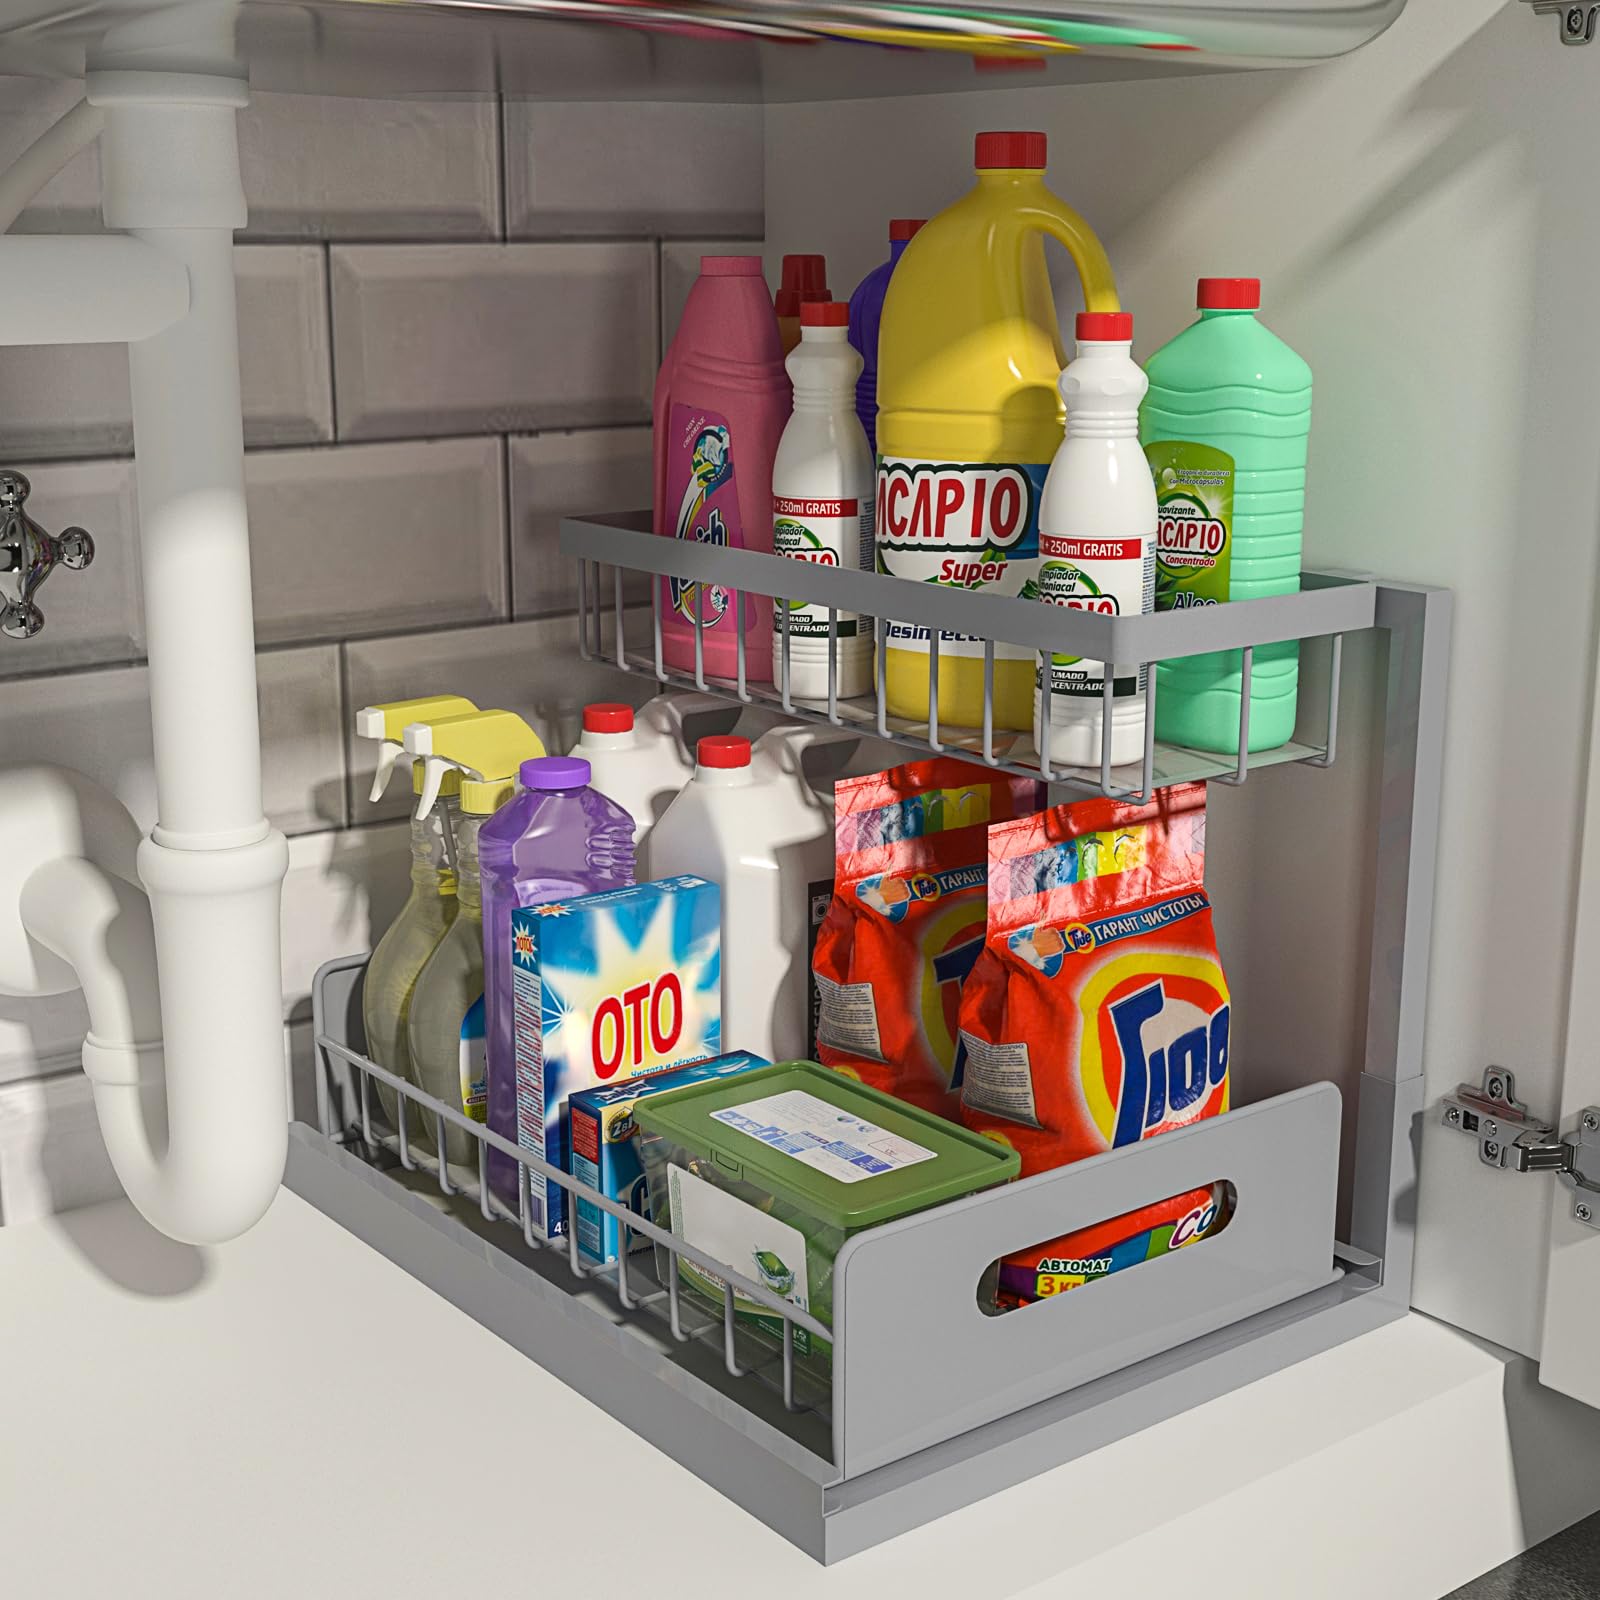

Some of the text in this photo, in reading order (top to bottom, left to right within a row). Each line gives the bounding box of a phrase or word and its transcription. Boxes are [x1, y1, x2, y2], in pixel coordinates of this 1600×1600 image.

[780, 500, 803, 513] 250ml
[805, 503, 841, 515] GRATIS
[1158, 506, 1196, 515] uavizante
[1050, 540, 1080, 556] 250ml
[1082, 543, 1123, 556] GRATIS
[1165, 554, 1216, 567] Concentrado
[939, 559, 1009, 589] Super
[940, 867, 985, 890] ГАРАНТ
[914, 877, 939, 900] Tide
[1094, 916, 1139, 942] ГАРАНТ
[1067, 929, 1093, 951] Tide
[1037, 1258, 1112, 1272] АВТОМАТ
[1040, 1276, 1055, 1295] 3
